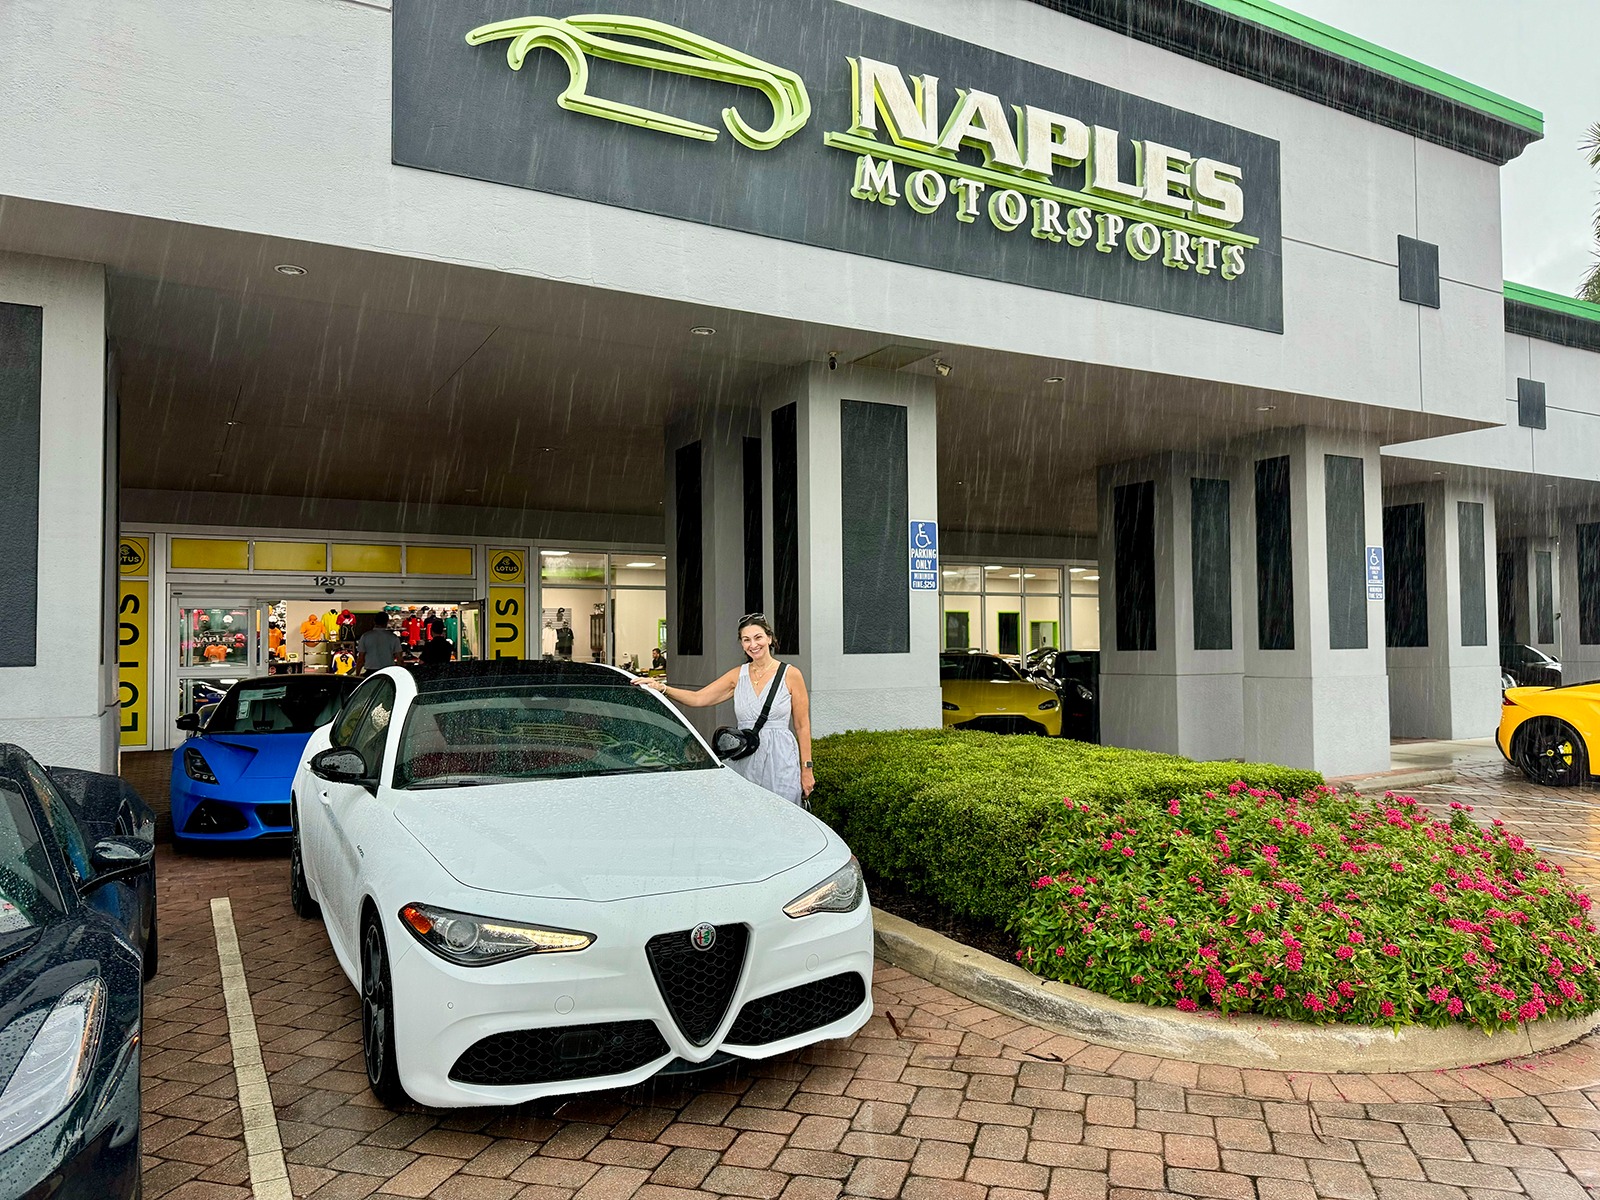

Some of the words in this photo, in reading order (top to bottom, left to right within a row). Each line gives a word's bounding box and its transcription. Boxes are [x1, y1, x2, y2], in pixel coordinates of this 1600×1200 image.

[845, 55, 1245, 227] NAPLES
[850, 154, 1246, 280] MOTORSPORTS
[911, 548, 937, 559] PARKING
[915, 559, 932, 570] ONLY
[313, 576, 345, 586] 1250
[495, 598, 519, 660] TUS
